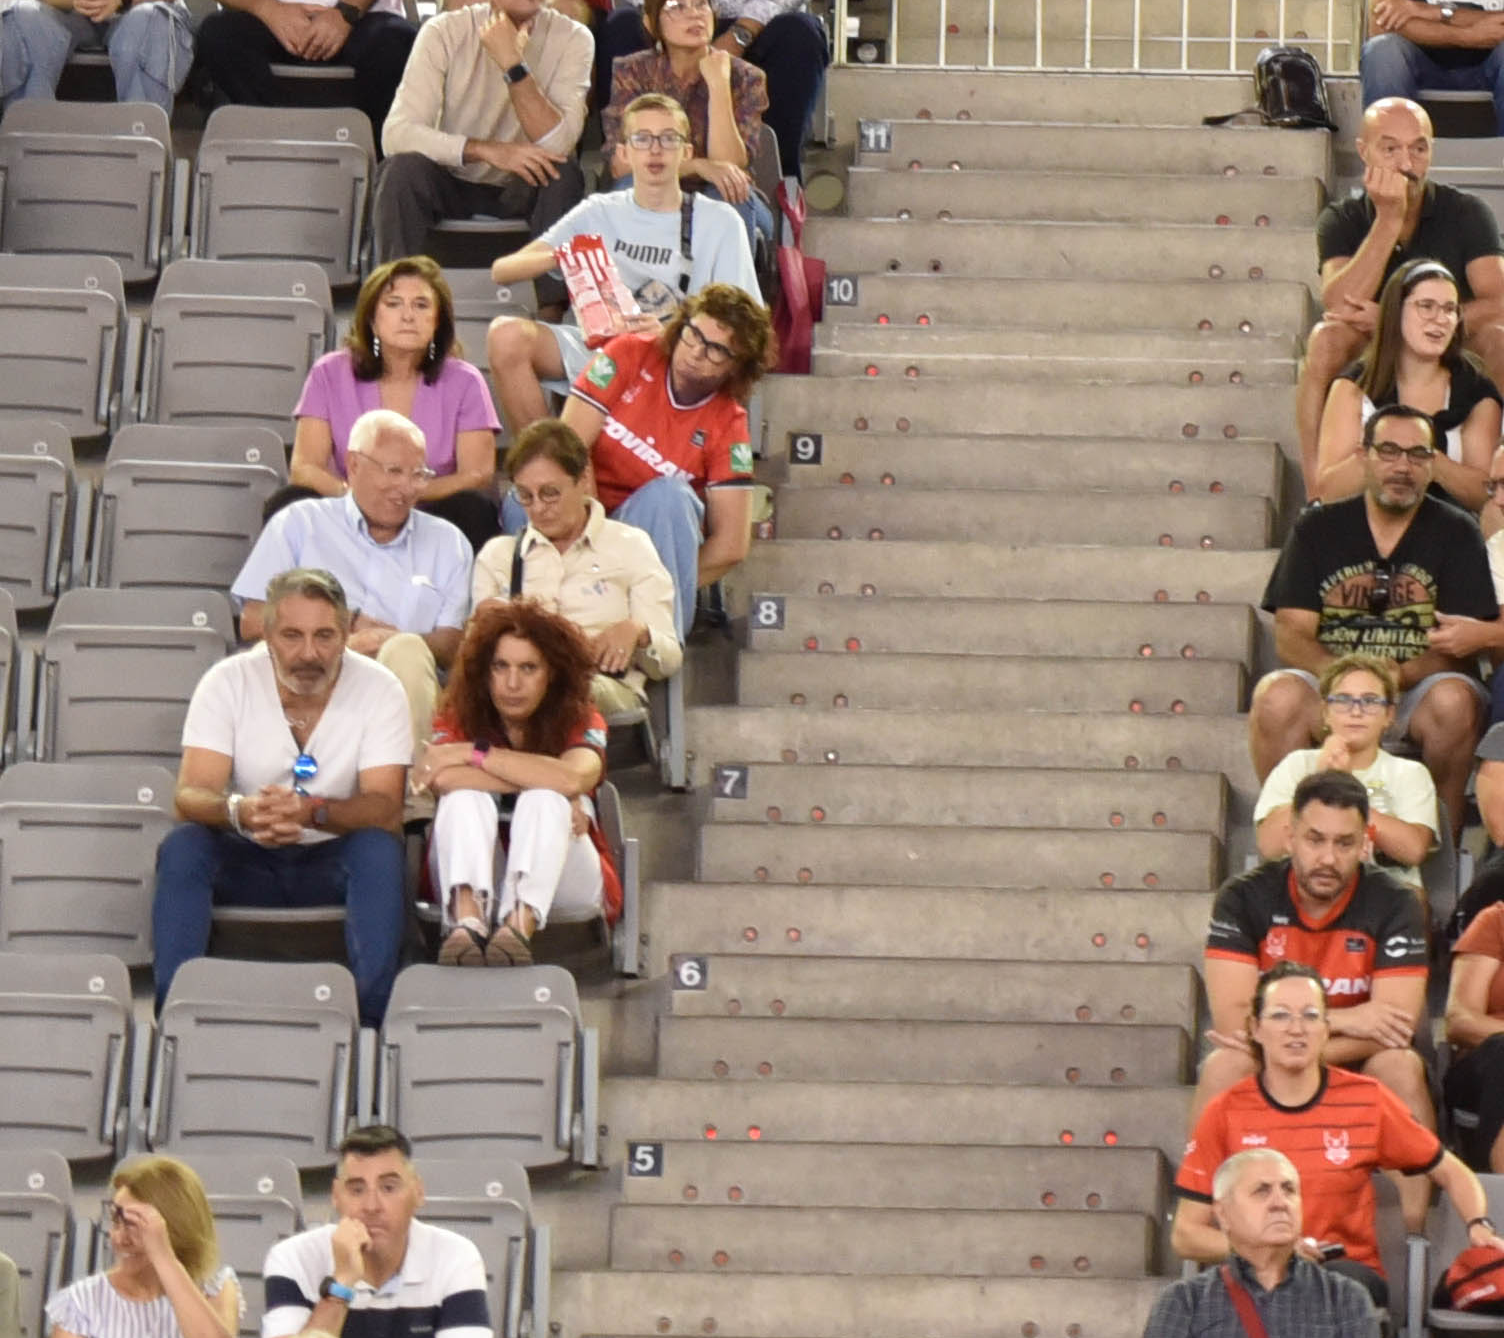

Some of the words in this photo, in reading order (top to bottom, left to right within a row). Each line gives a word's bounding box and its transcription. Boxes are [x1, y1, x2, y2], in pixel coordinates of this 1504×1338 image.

[864, 127, 887, 150] 11
[613, 239, 673, 266] PUMA
[829, 280, 853, 303] 10
[796, 436, 815, 461] 9
[758, 600, 778, 626] 8
[722, 769, 741, 796] 7
[679, 960, 702, 987] 6
[634, 1145, 655, 1172] 5
